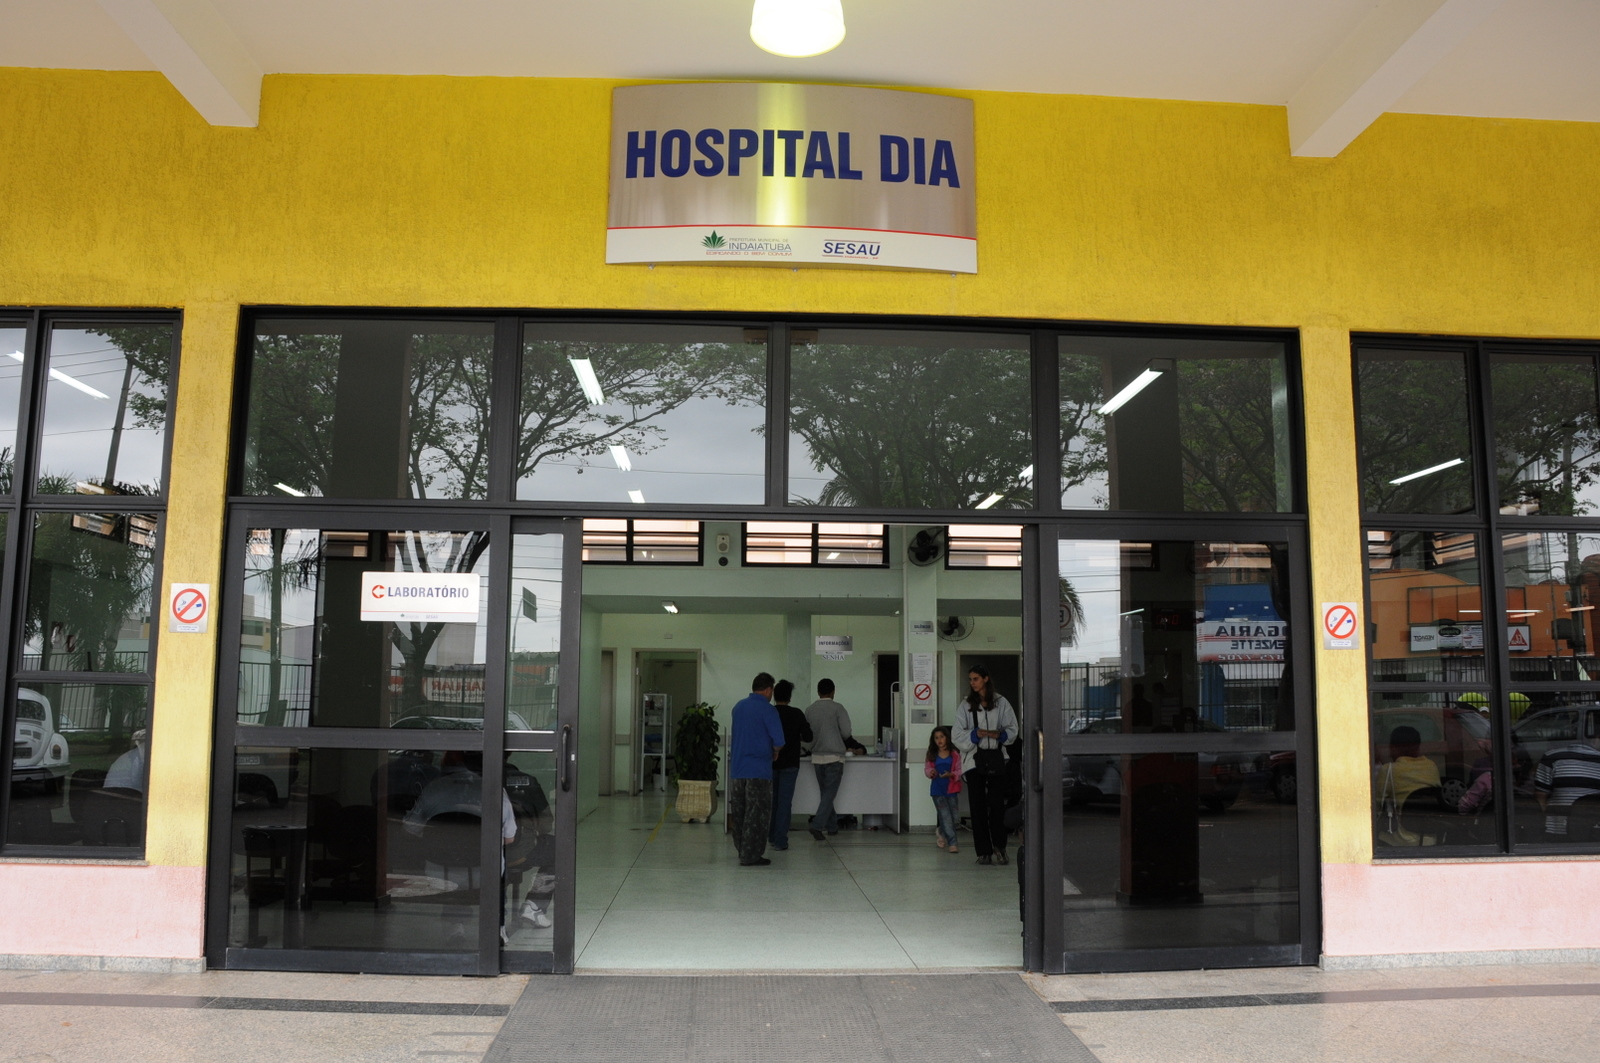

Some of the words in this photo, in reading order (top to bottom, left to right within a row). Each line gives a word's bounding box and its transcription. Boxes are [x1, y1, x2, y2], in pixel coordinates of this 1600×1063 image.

[625, 128, 863, 180] HOSPITAL
[880, 134, 961, 189] DIA
[728, 242, 792, 251] INDAIATUBA
[823, 242, 881, 256] SESAU
[387, 584, 470, 598] LABORATÓRIO
